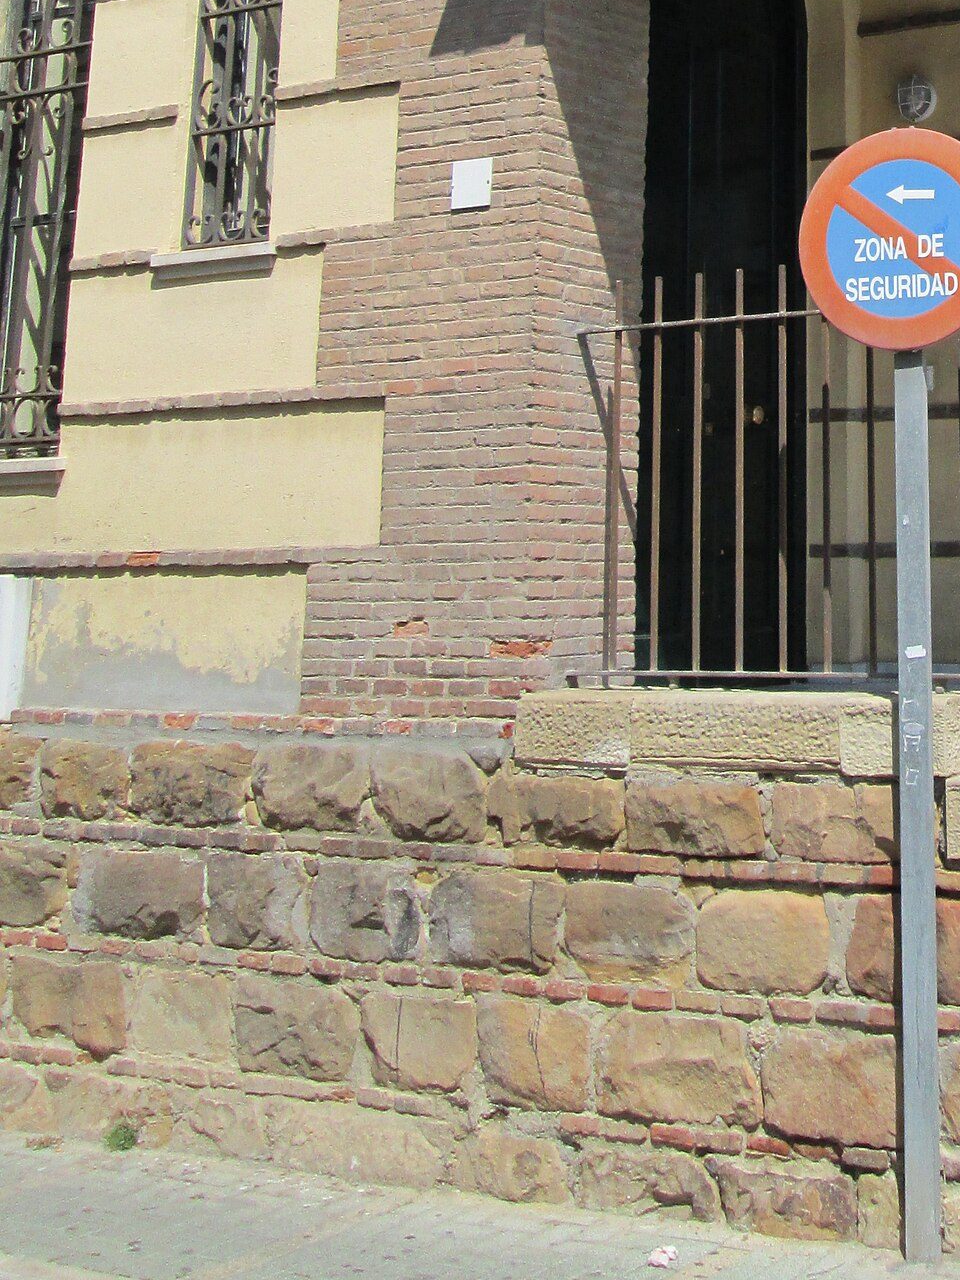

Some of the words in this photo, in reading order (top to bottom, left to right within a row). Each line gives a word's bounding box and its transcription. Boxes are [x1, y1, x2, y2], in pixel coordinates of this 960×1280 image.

[854, 235, 908, 263] ZONA
[917, 233, 945, 258] DE
[845, 272, 959, 302] SEGURIDAD
